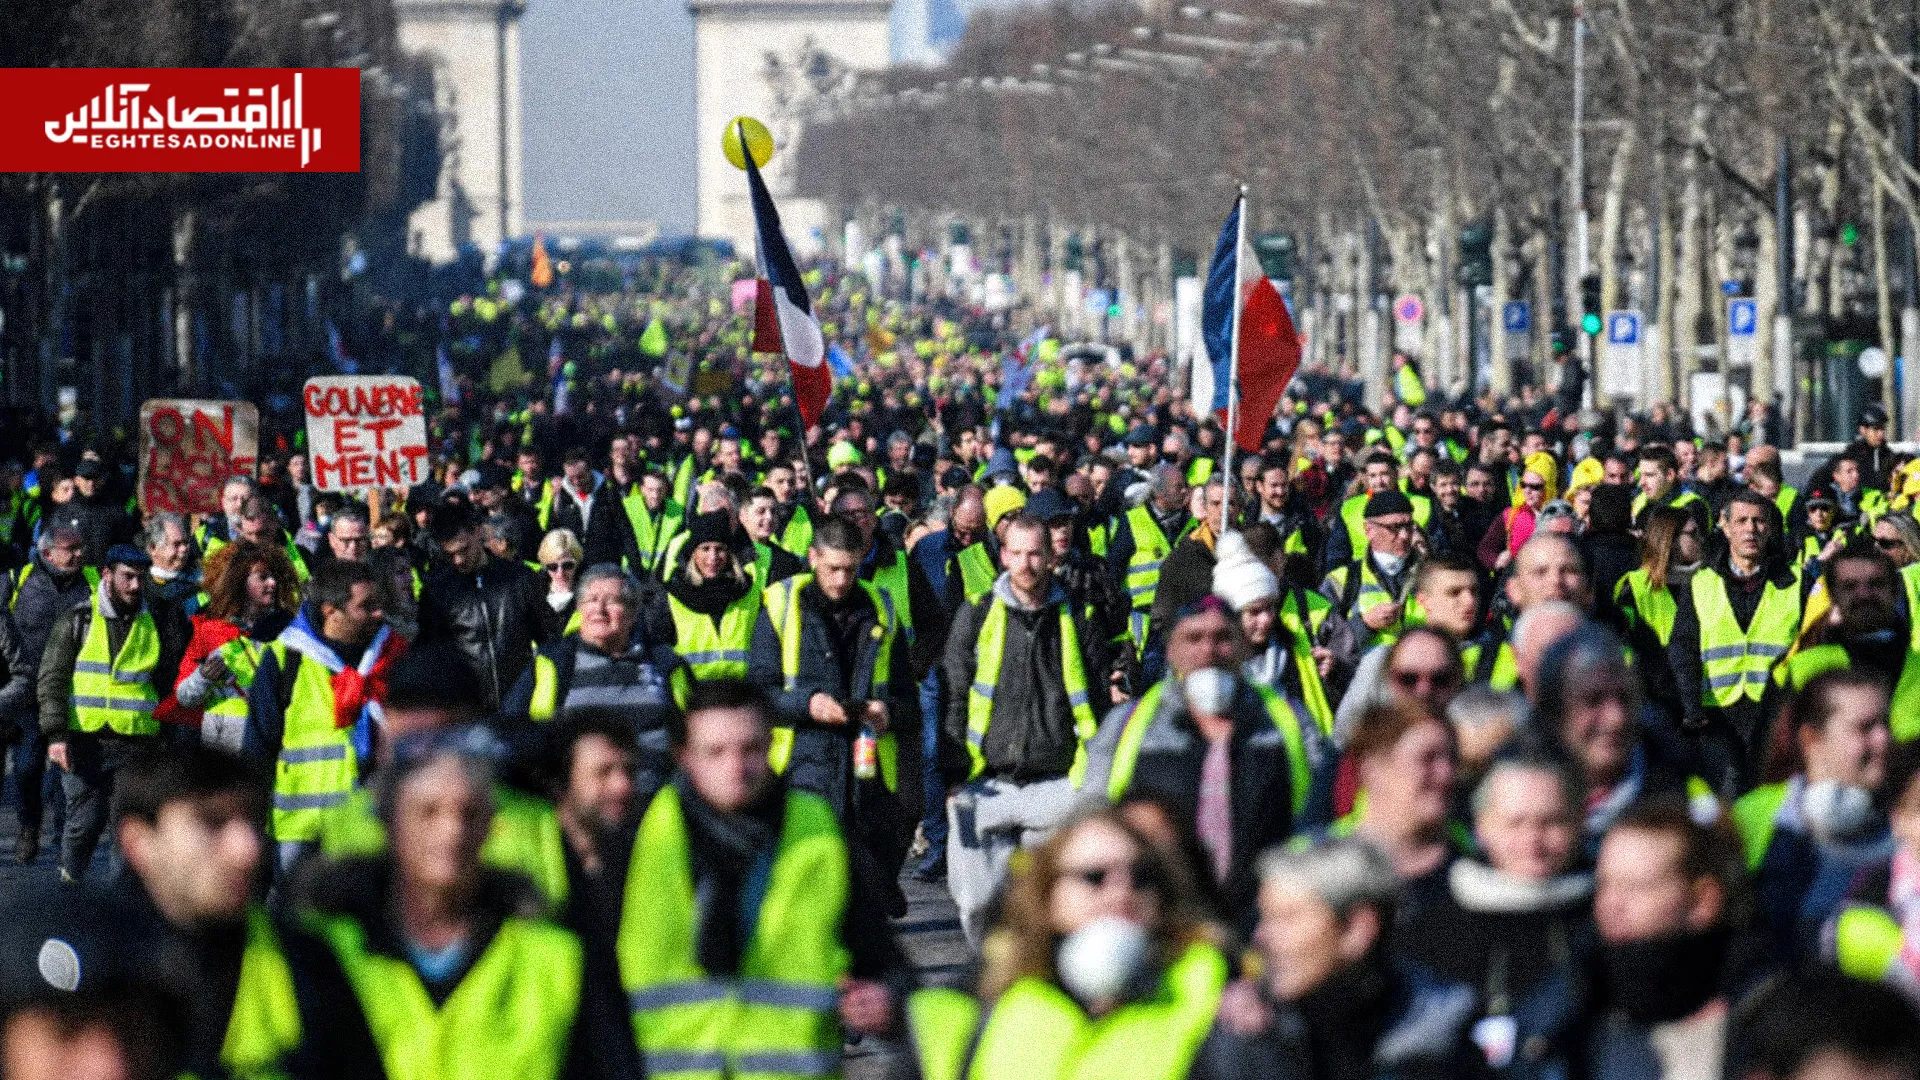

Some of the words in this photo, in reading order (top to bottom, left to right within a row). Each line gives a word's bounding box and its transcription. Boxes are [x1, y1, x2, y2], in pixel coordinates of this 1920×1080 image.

[1614, 318, 1633, 339] P
[1736, 305, 1752, 330] P
[150, 405, 233, 453] ON
[333, 418, 403, 454] ET
[315, 444, 428, 489] MENT
